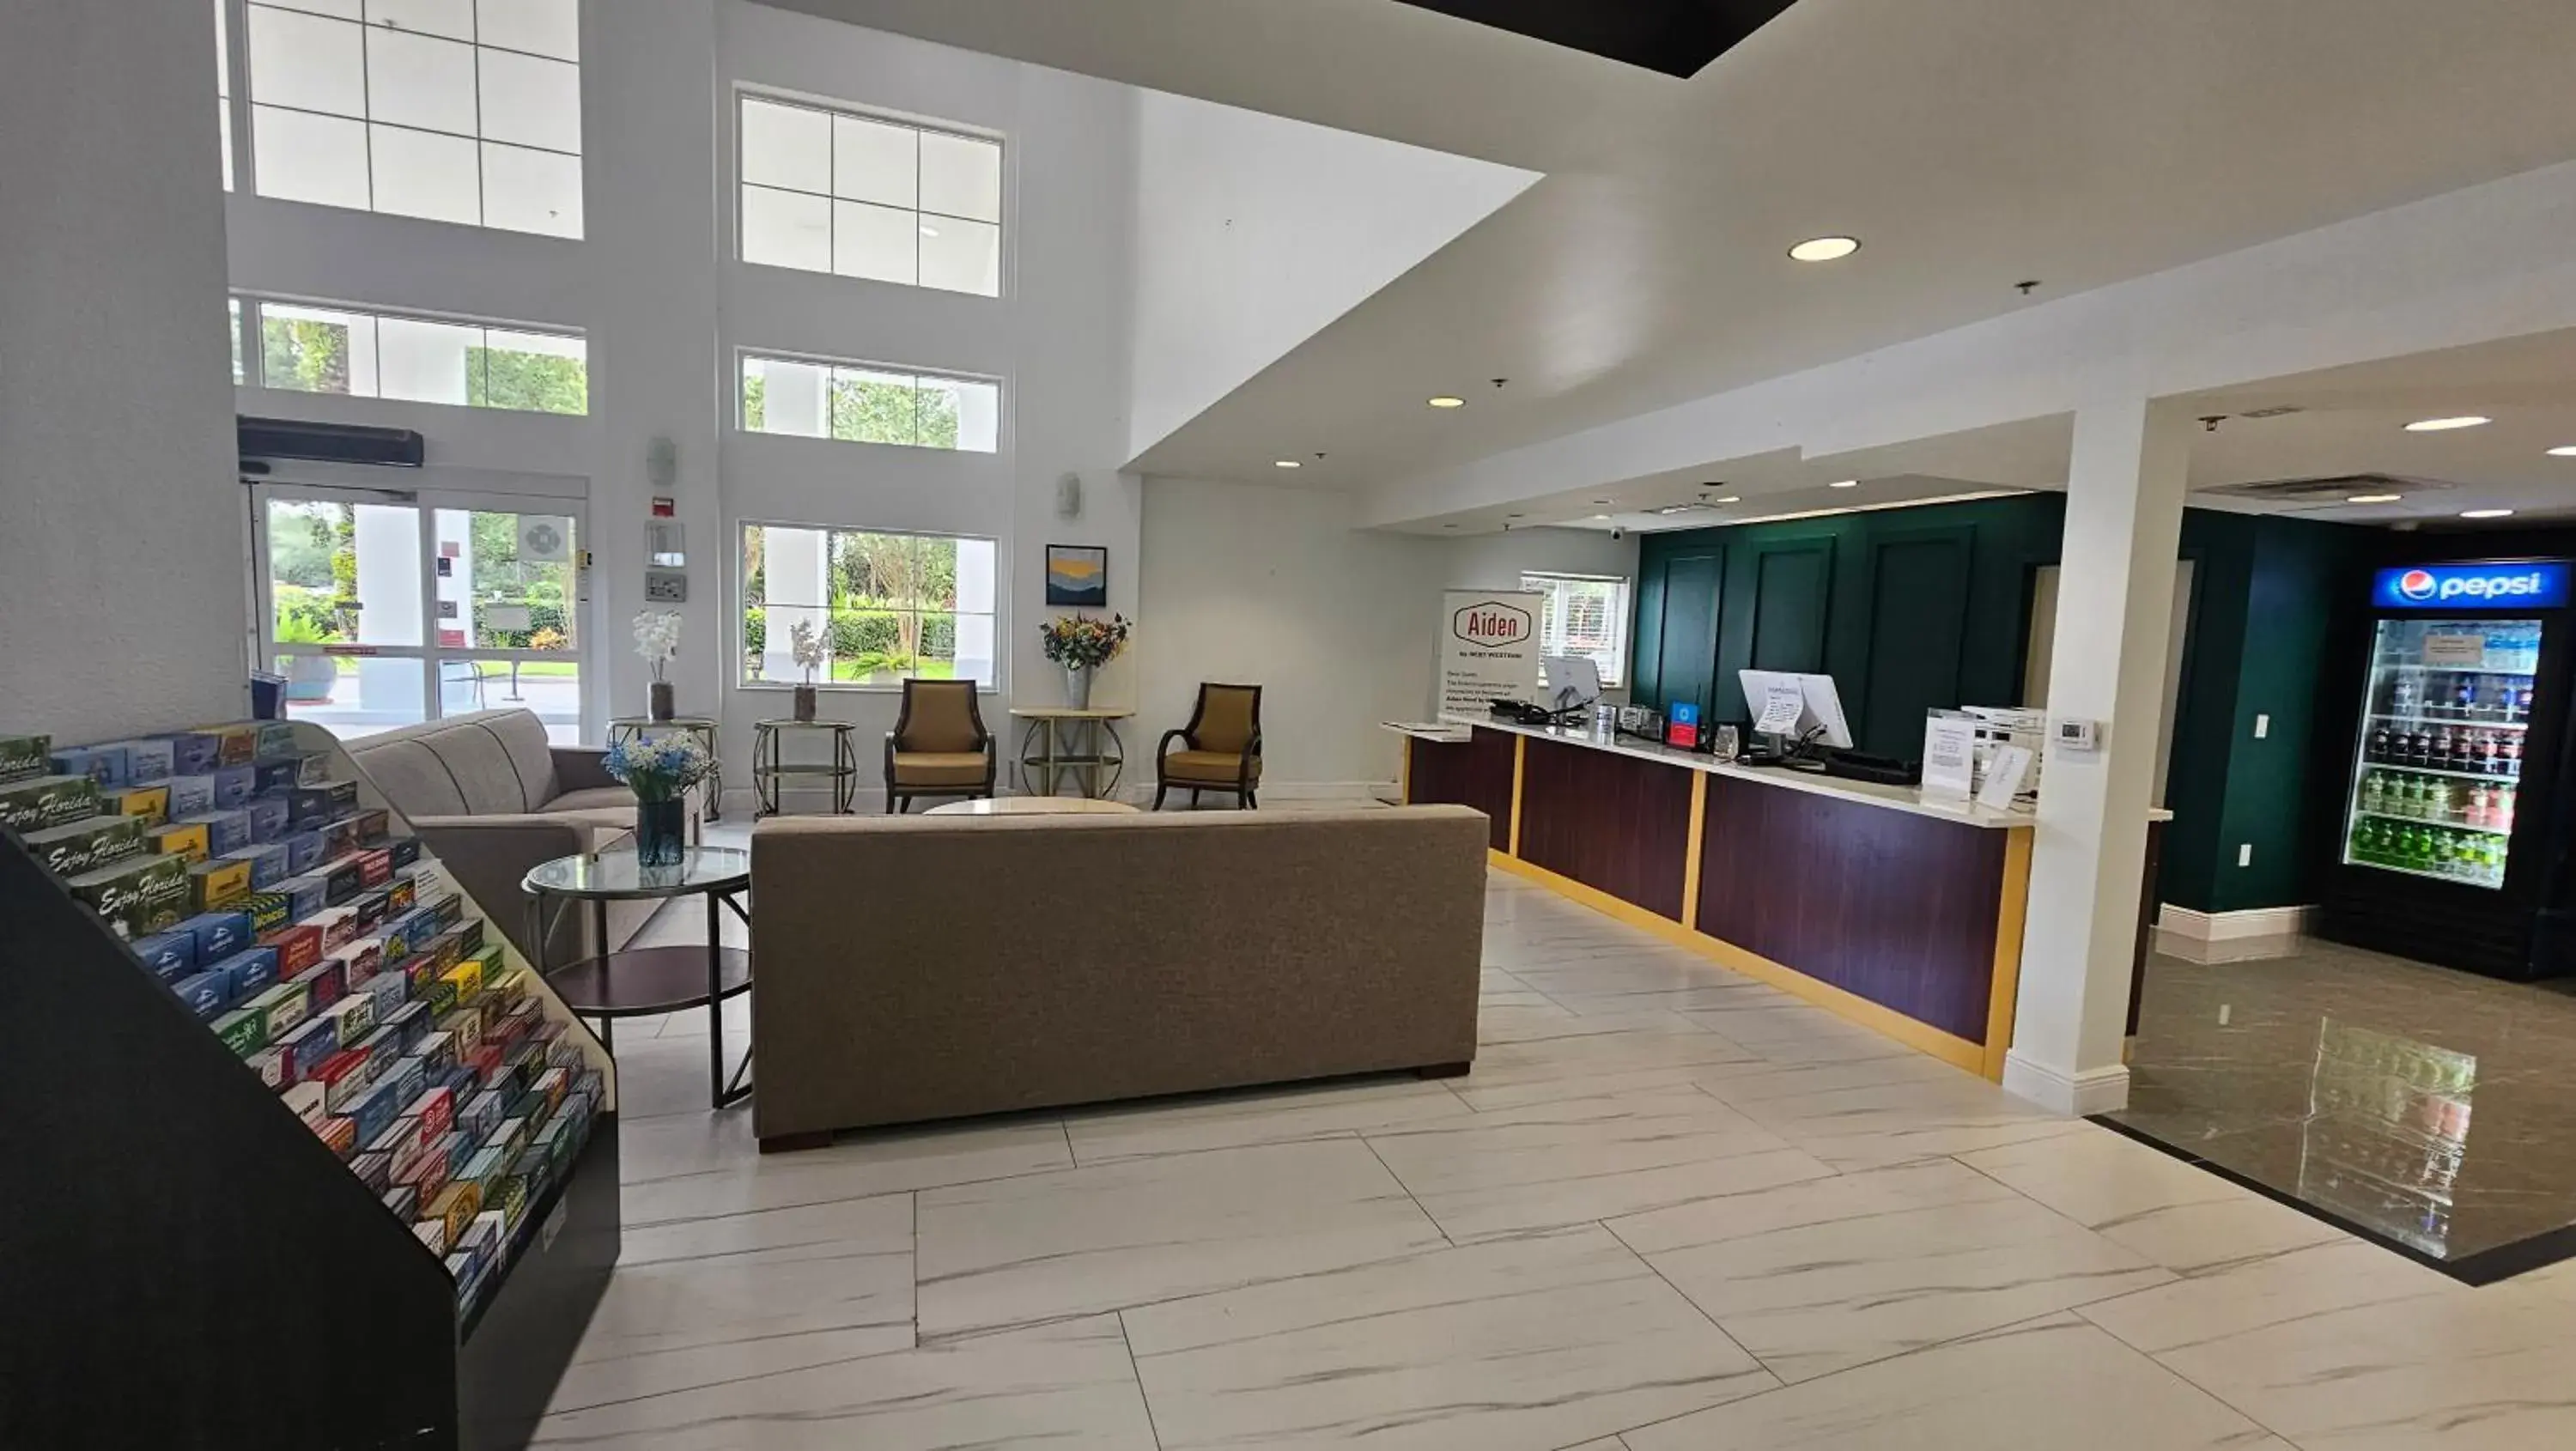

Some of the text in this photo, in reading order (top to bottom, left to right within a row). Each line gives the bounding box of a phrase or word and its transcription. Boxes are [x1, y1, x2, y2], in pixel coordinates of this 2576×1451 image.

[2440, 573, 2542, 599] pepsi
[1467, 611, 1517, 636] Aiden
[39, 793, 91, 818] Florida
[49, 835, 139, 873] Enjoy Florida
[99, 874, 184, 916] Enjoy Florida
